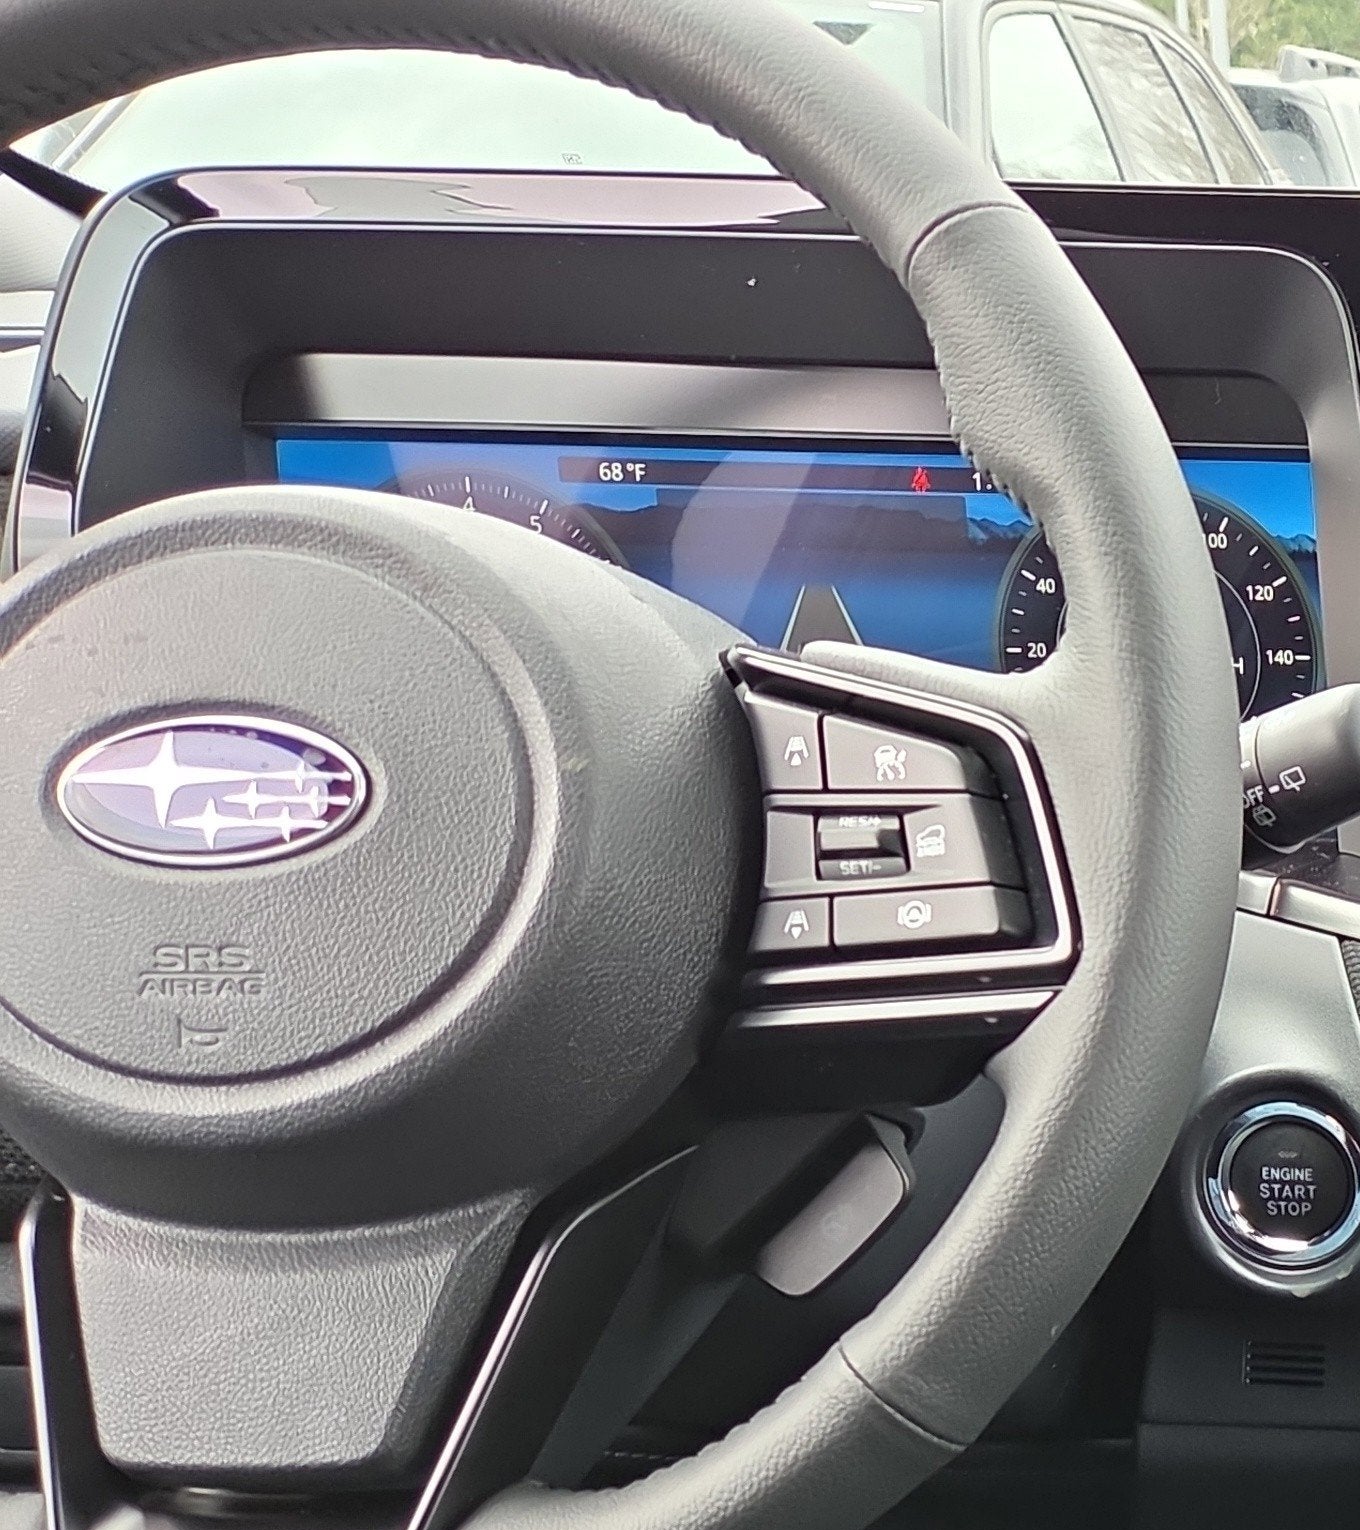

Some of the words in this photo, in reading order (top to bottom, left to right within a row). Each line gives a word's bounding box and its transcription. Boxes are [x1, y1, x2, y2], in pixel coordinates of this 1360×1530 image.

[529, 515, 543, 534] 5
[1036, 578, 1056, 594] 40
[1245, 585, 1274, 601] 120
[1027, 642, 1047, 658] 20
[1265, 649, 1294, 665] 140
[152, 944, 255, 972] SRS
[138, 977, 267, 998] AIRBAG
[1261, 1166, 1314, 1182] ENGINE
[1259, 1183, 1317, 1200] START
[1267, 1200, 1312, 1216] STOP
